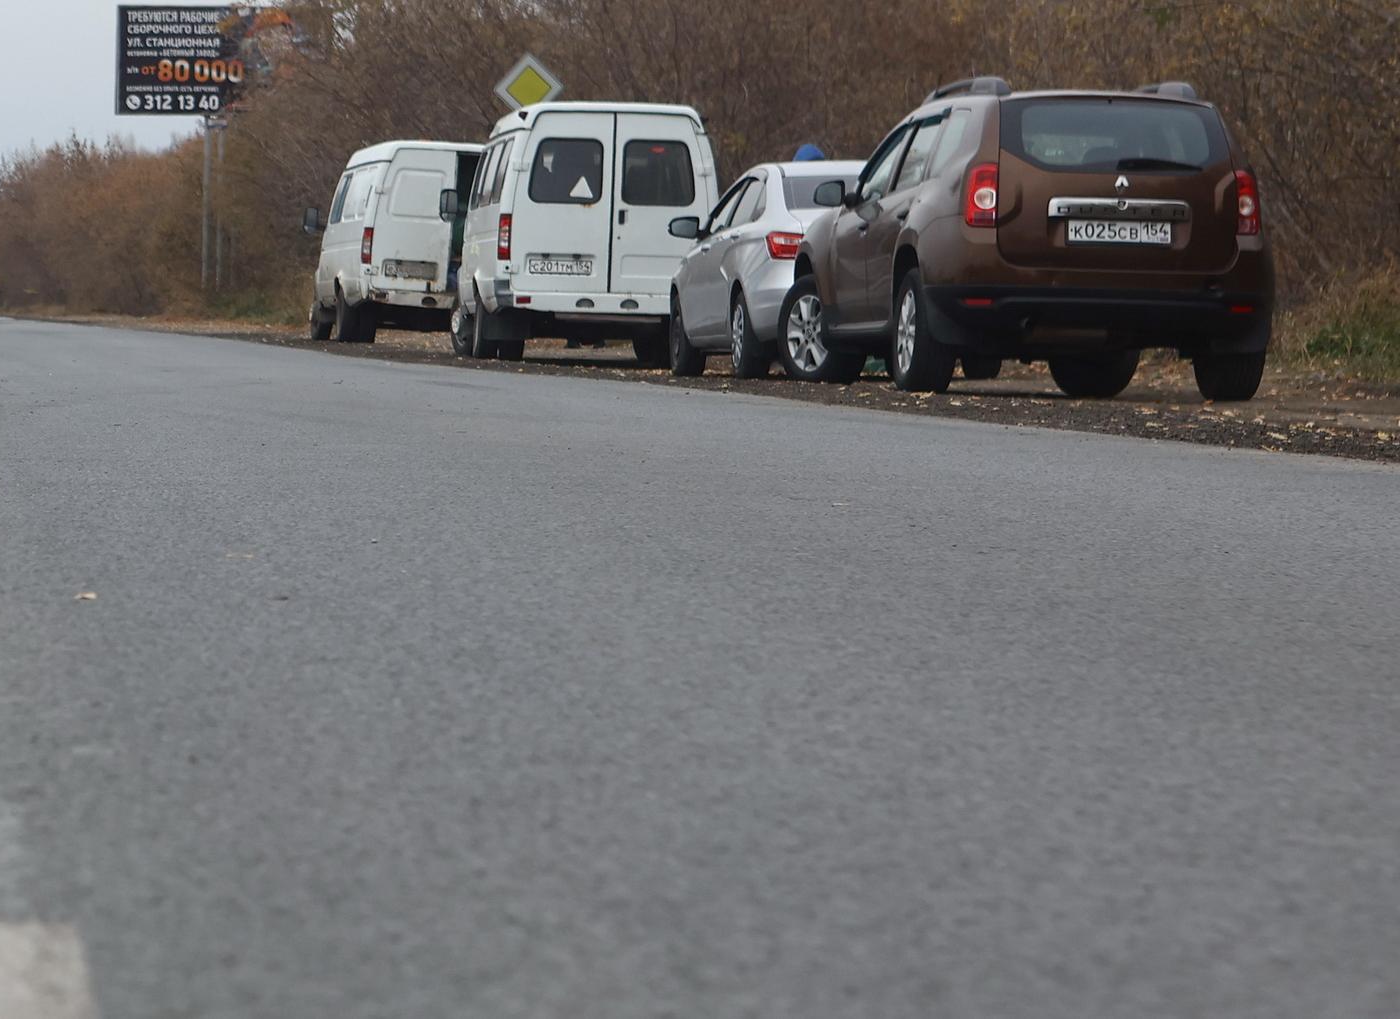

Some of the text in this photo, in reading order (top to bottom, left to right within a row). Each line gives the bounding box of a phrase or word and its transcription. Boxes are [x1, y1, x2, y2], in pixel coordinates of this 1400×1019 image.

[127, 10, 220, 23] ТРЕБУЮТСЯ РАБОЧИЕ
[127, 24, 220, 35] СБОРОЧНОГО ЦЕХА
[126, 38, 220, 48] УЛ. СТАНЦИОННАЯ
[157, 59, 190, 82] 80
[194, 59, 245, 83] 000
[144, 94, 219, 110] 312 13 40
[1073, 223, 1168, 240] К025СВ 154
